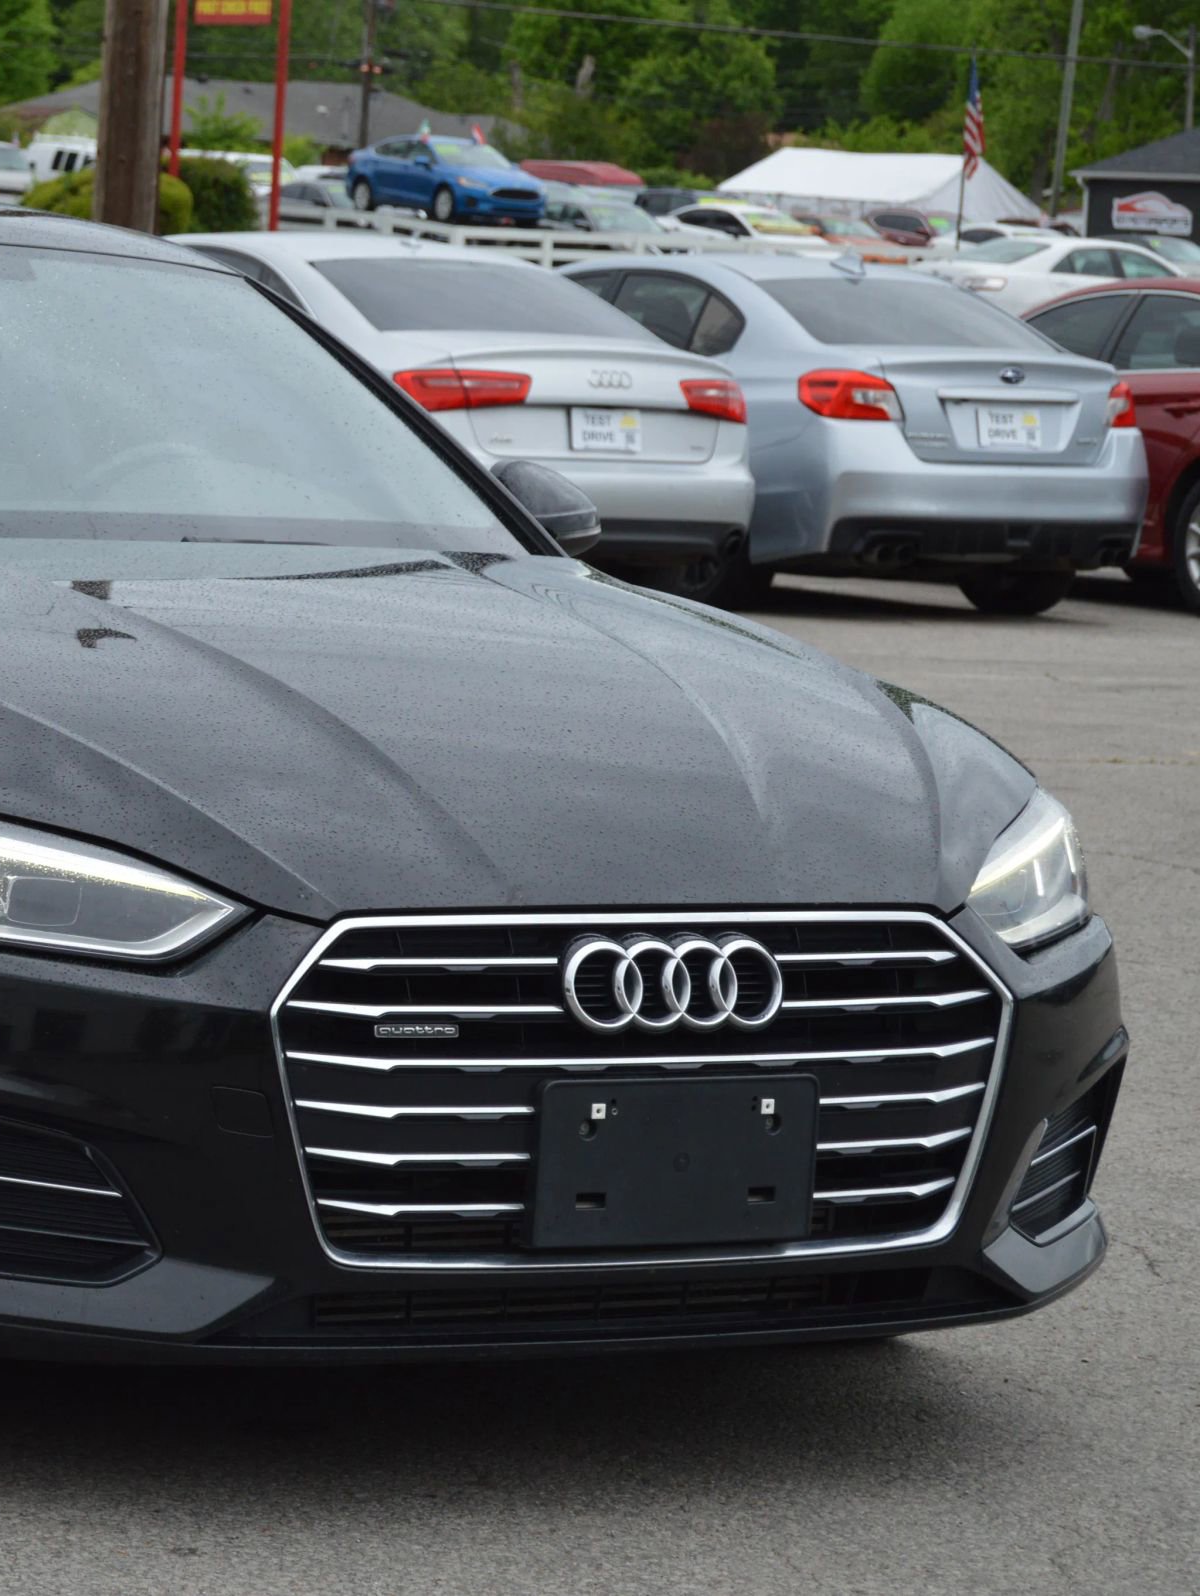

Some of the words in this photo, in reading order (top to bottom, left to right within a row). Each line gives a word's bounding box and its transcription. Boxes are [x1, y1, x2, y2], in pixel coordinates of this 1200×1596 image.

[585, 413, 613, 427] TEST
[988, 413, 1014, 425] TEST
[582, 430, 615, 443] DRIVE
[987, 428, 1017, 440] DRIVE
[378, 1025, 456, 1036] quattro
